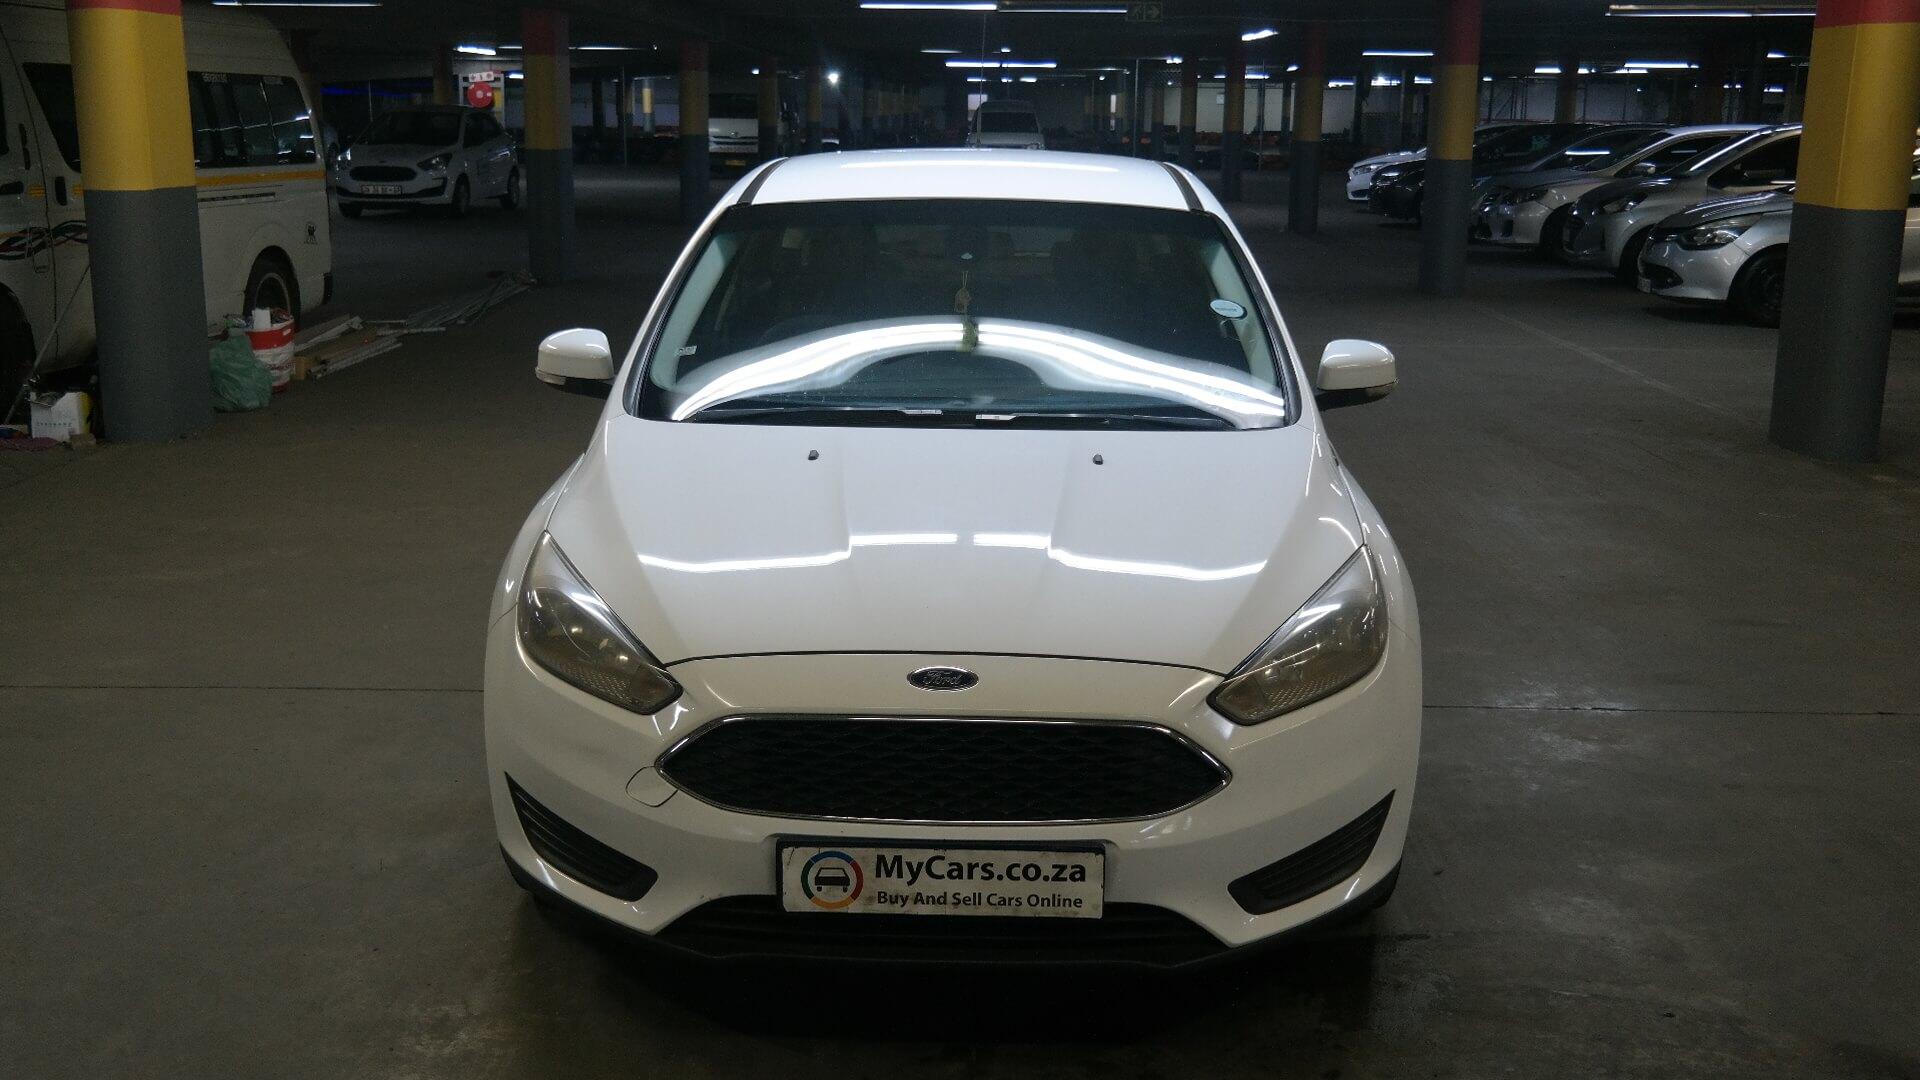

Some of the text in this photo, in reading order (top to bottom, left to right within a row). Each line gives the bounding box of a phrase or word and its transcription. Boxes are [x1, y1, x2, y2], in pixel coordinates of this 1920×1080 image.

[922, 670, 963, 685] Ford
[875, 854, 1086, 886] MyCars.co.za
[877, 891, 1083, 908] Buy And Sell Cars Online
